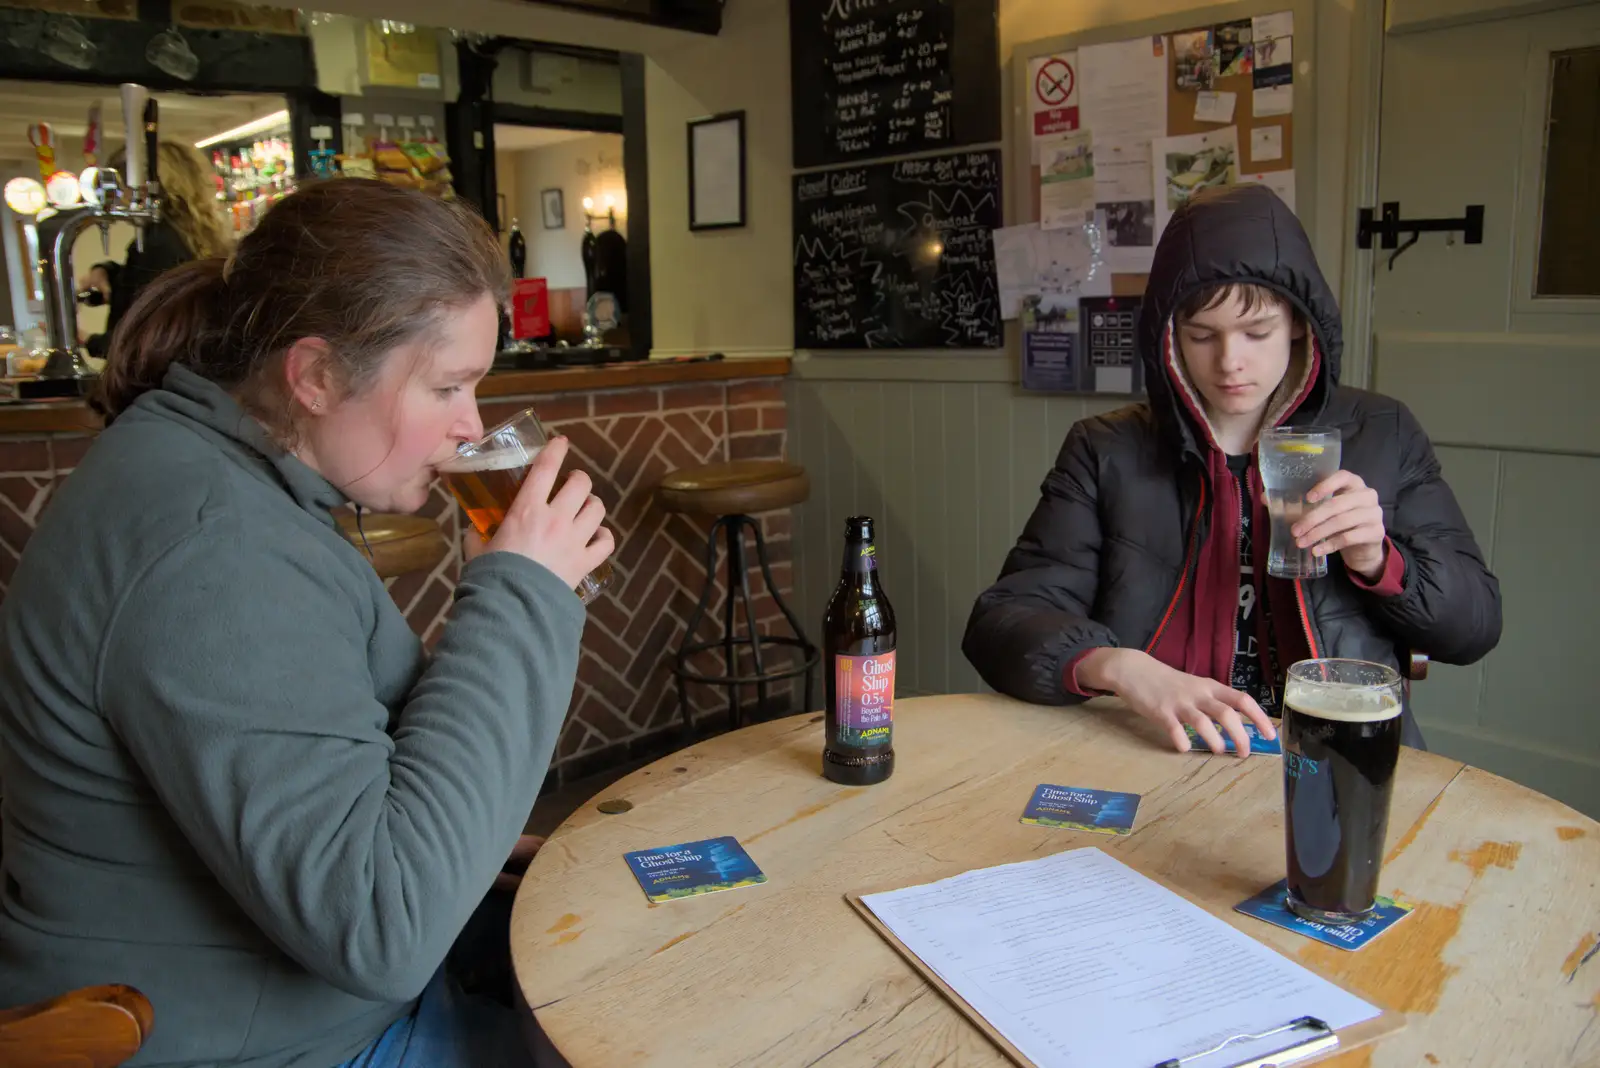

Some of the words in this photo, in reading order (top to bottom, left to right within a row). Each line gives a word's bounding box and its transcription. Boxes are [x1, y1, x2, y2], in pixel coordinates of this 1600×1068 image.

[1049, 110, 1062, 120] No
[1042, 120, 1071, 133] vaping
[862, 658, 893, 675] Ghost
[861, 676, 888, 692] Ship
[861, 693, 884, 705] 0.5%
[861, 706, 881, 716] Beyond
[861, 715, 869, 723] the
[1043, 788, 1068, 796] Time
[1041, 793, 1072, 801] Ghost
[1073, 796, 1098, 805] Ship
[634, 854, 664, 863] Time
[664, 850, 683, 858] for
[640, 858, 674, 868] Ghost
[674, 854, 702, 863] Ship
[1307, 922, 1325, 931] for
[1324, 927, 1356, 943] Time
